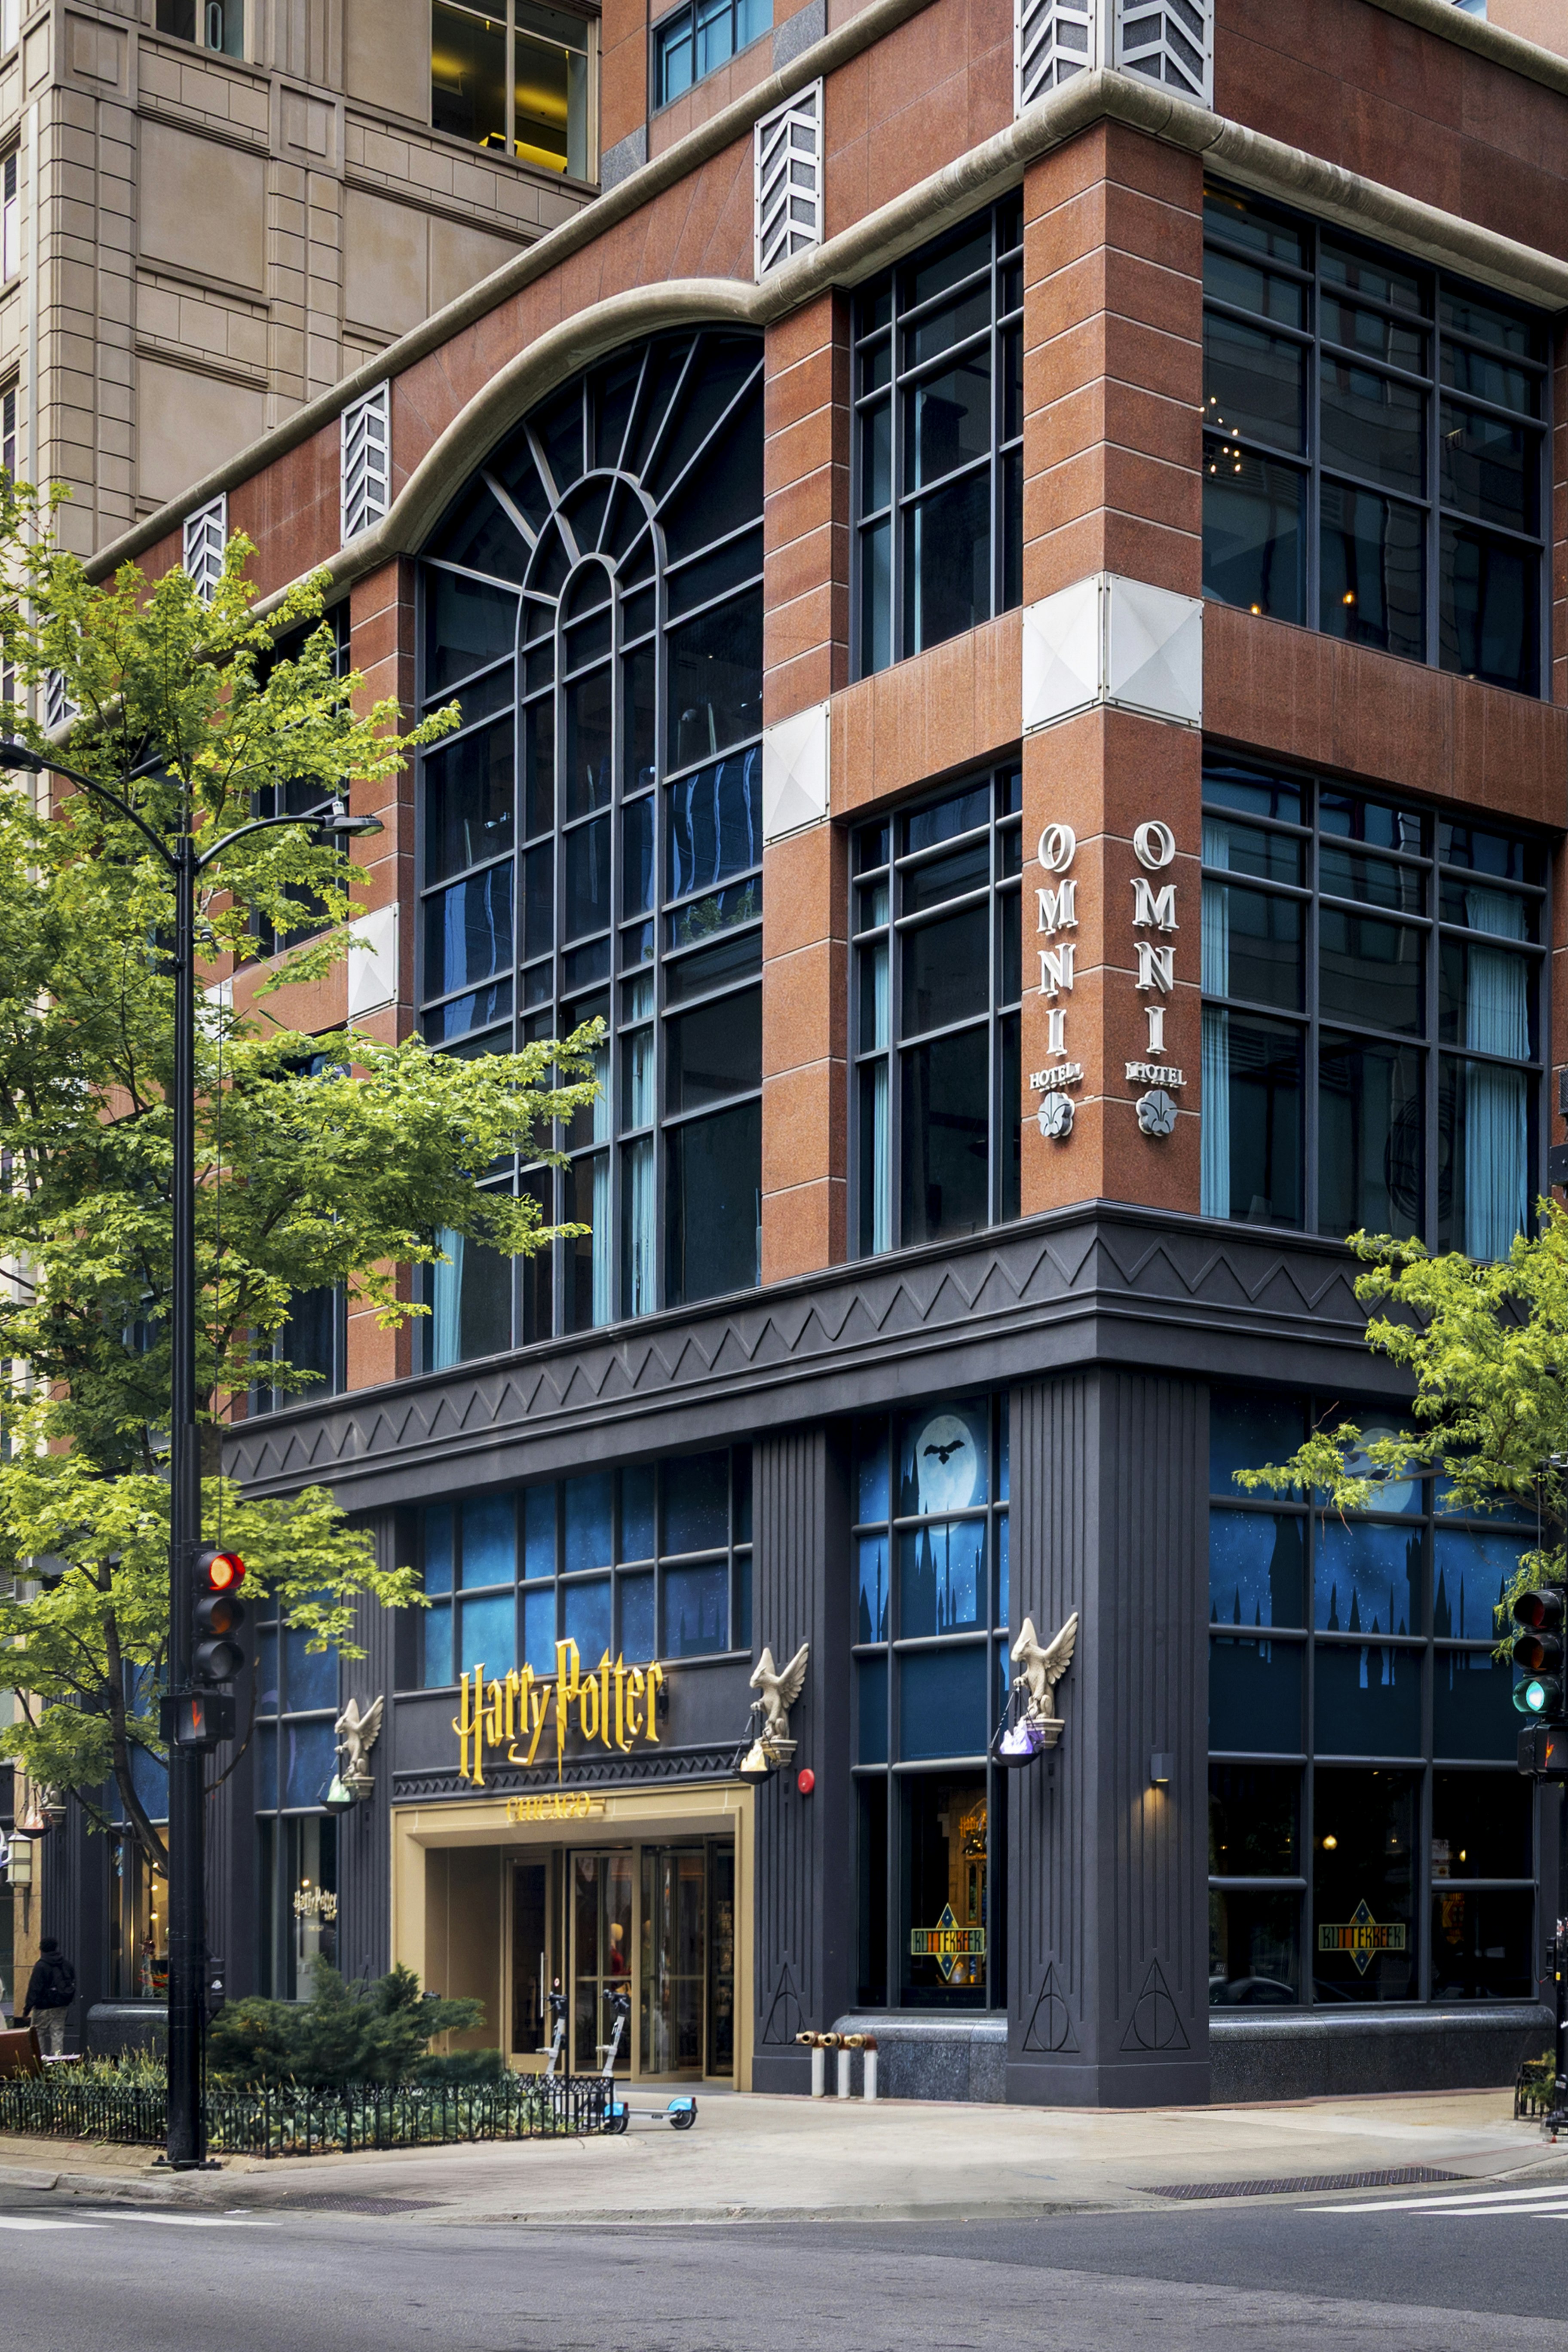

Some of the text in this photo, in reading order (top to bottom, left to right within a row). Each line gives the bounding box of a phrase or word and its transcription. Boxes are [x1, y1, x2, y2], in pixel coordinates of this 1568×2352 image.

[1035, 823, 1078, 1056] OMNI
[1130, 820, 1179, 1054] OMNI
[1030, 1062, 1084, 1092] HOTEL
[1125, 1061, 1187, 1088] HOTEL
[452, 1637, 663, 1788] Harry Potter
[506, 1791, 591, 1822] CHICAGO
[915, 1929, 982, 1953] BUTTERBEER
[1322, 1925, 1401, 1949] BUTTERBEER
